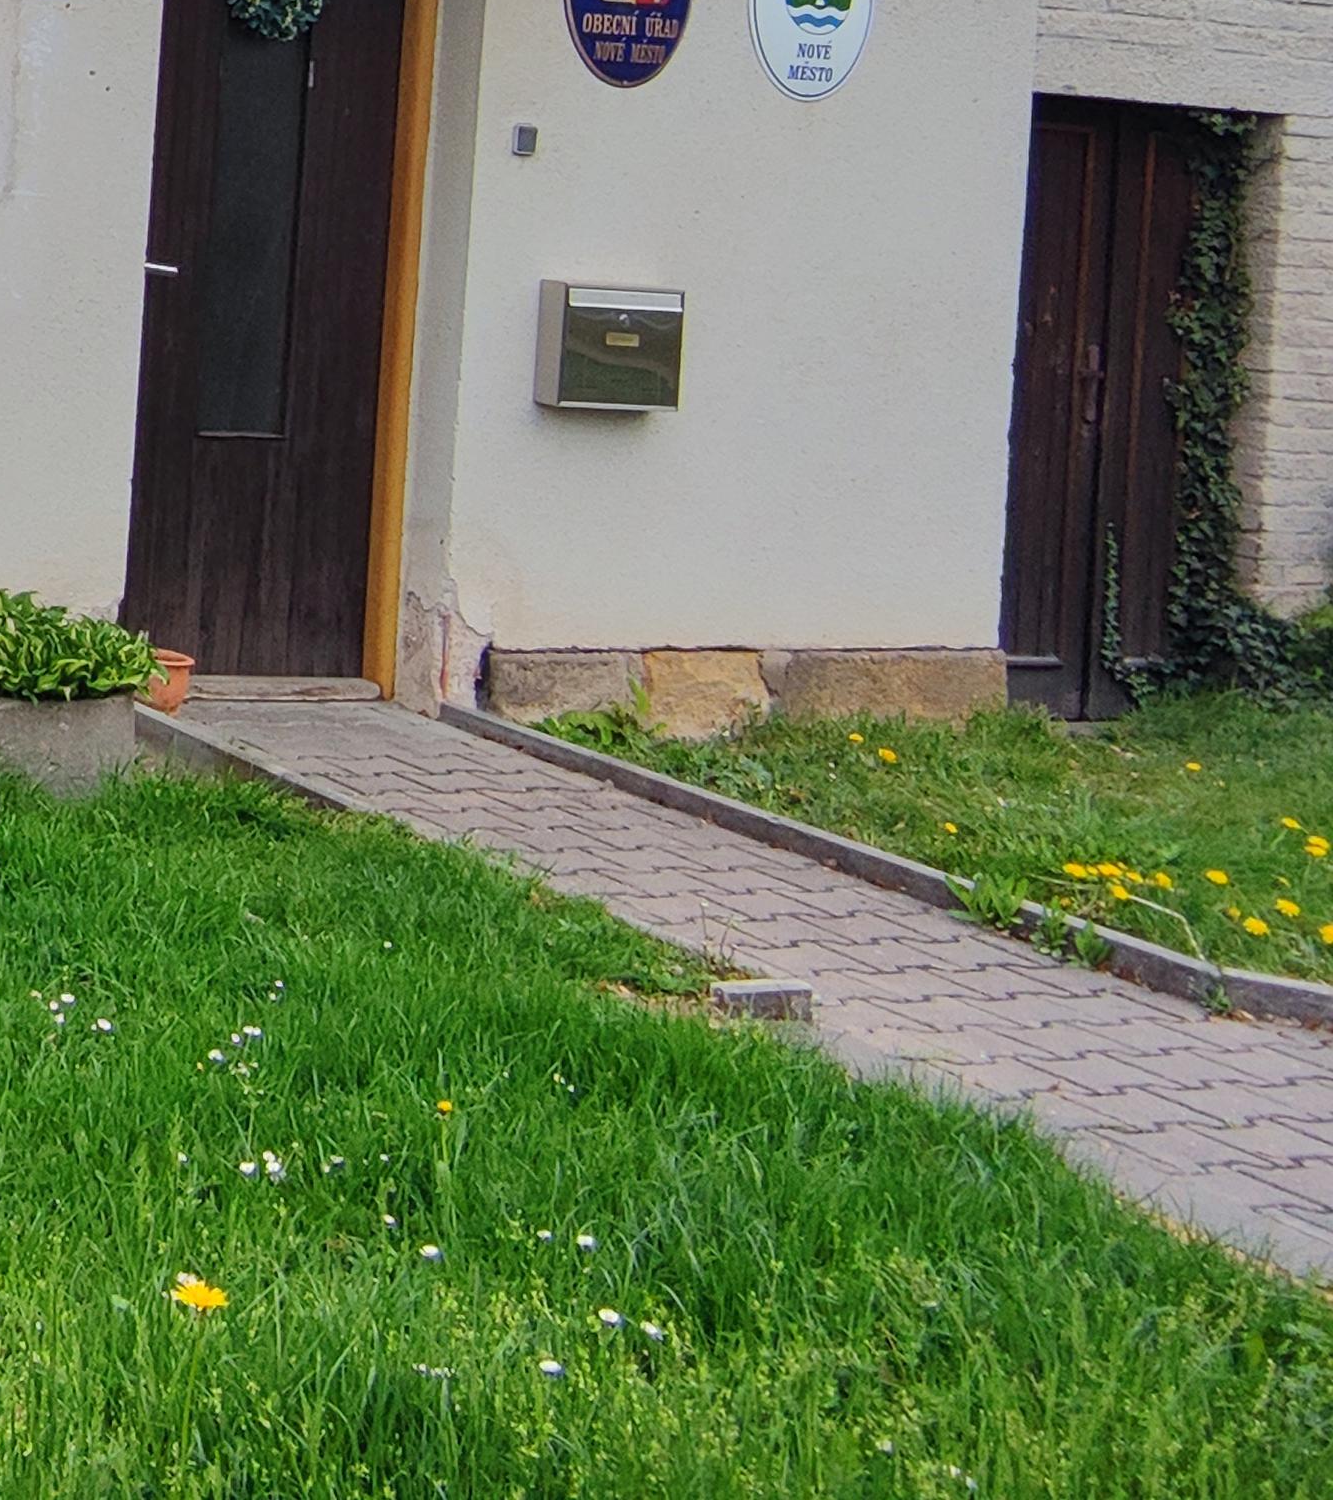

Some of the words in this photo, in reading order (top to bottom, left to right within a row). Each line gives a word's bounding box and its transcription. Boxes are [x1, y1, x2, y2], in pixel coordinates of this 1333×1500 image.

[582, 10, 640, 36] OBECNÍ
[644, 11, 679, 38] ÚŘAD
[594, 37, 627, 62] NOVÉ
[629, 39, 667, 64] MĚSTO
[797, 40, 833, 60] NOVÉ
[787, 61, 834, 83] MĚSTO
